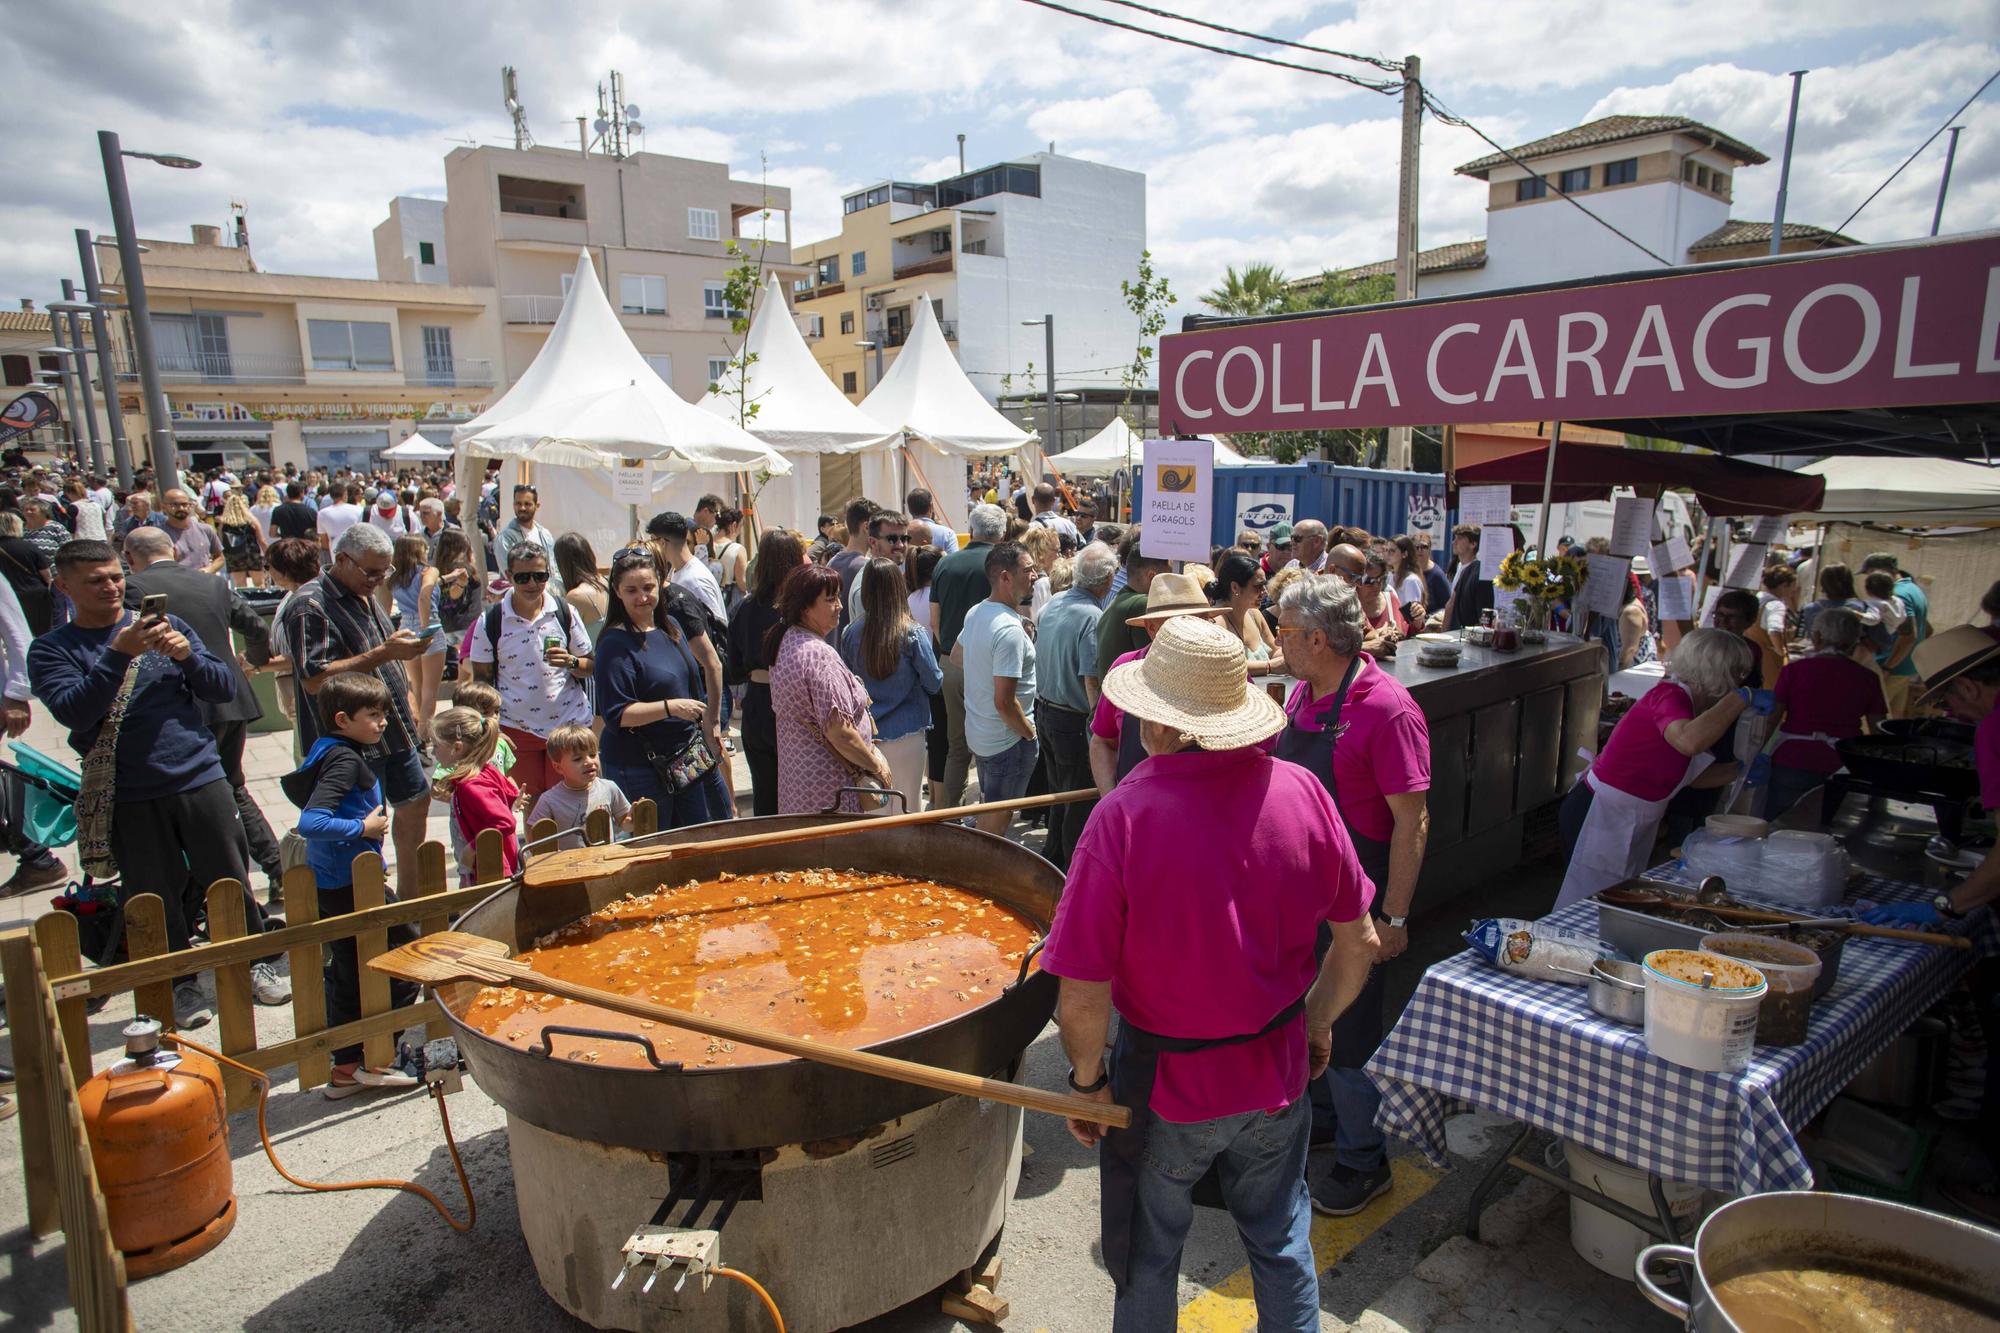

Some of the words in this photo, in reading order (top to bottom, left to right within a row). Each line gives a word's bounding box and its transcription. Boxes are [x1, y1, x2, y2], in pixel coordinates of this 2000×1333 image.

[1175, 333, 1401, 419] COLLA
[262, 403, 277, 414] LA
[319, 403, 353, 414] FRUTA
[356, 403, 363, 414] Y
[366, 403, 415, 414] VERDURA
[1152, 500, 1181, 511] PAELLA
[1184, 502, 1195, 512] DE
[1152, 514, 1195, 526] CARAGOLS
